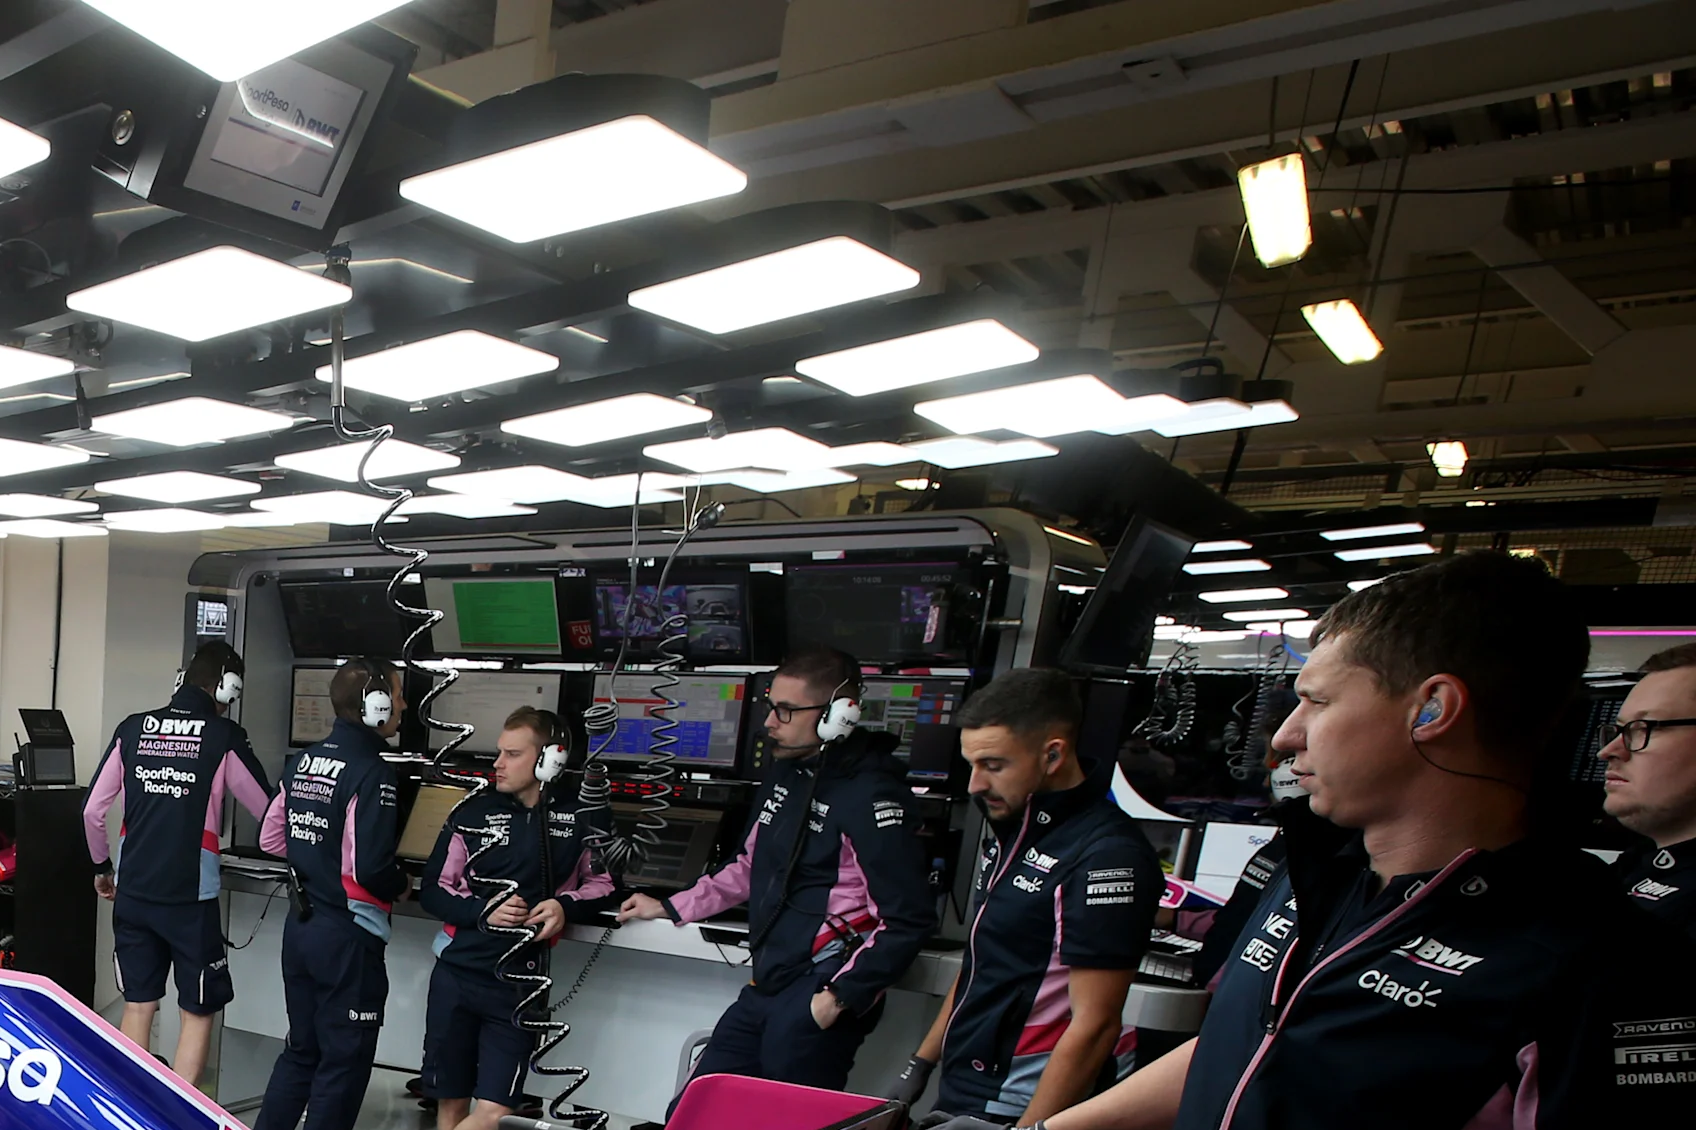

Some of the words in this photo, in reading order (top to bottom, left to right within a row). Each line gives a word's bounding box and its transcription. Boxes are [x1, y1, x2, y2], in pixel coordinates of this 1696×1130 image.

[160, 719, 205, 735] BWT
[137, 749, 176, 757] MINERALIZED
[177, 751, 199, 759] WATER
[138, 740, 201, 752] MAGNESIUM
[135, 765, 196, 783] SportPesa
[309, 756, 346, 778] BWT
[144, 780, 182, 798] Racing
[1036, 853, 1059, 869] BWT
[1012, 875, 1038, 893] Claro
[1087, 882, 1134, 895] PIRELLI
[1086, 896, 1134, 905] BOMBARDIER
[1415, 937, 1485, 970] BWT
[1357, 969, 1426, 1008] Claro
[360, 1011, 378, 1021] BWT
[1623, 1020, 1696, 1033] RAVENO
[1614, 1043, 1696, 1065] PIREL
[1616, 1071, 1696, 1085] BOMBARD
